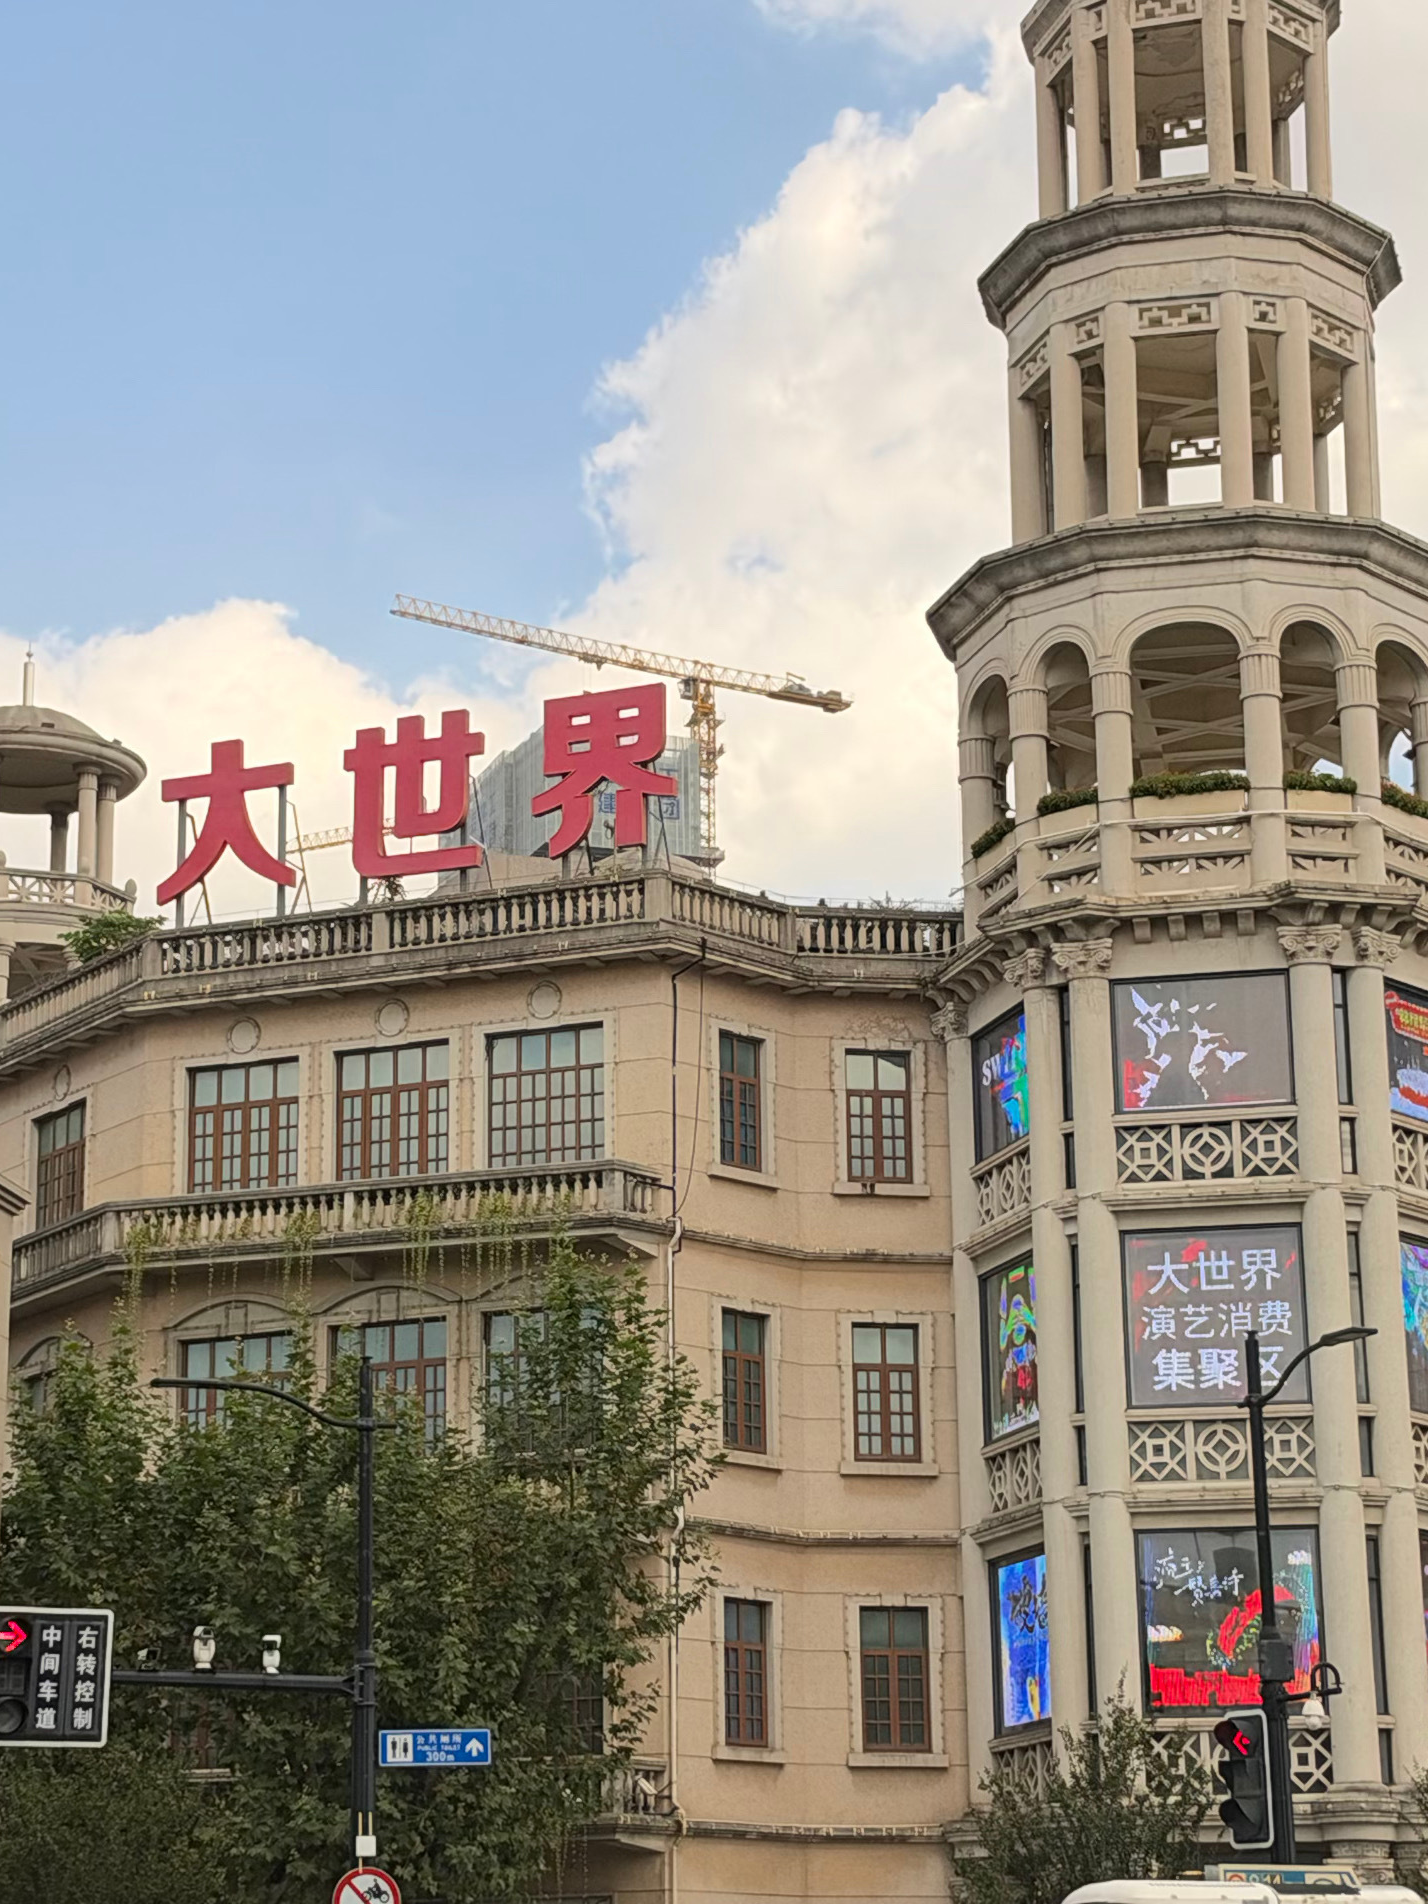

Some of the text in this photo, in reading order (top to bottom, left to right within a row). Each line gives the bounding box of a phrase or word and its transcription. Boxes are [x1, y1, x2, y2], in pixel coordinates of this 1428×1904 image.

[157, 683, 677, 905] 大世界
[1147, 1248, 1282, 1295] 大世界
[1141, 1300, 1293, 1341] 演艺消费
[1152, 1346, 1287, 1392] 集聚区
[35, 1625, 62, 1729] 中间车道
[72, 1626, 98, 1730] 右转控制
[416, 1734, 462, 1745] 公共厕所
[426, 1751, 455, 1762] 300m
